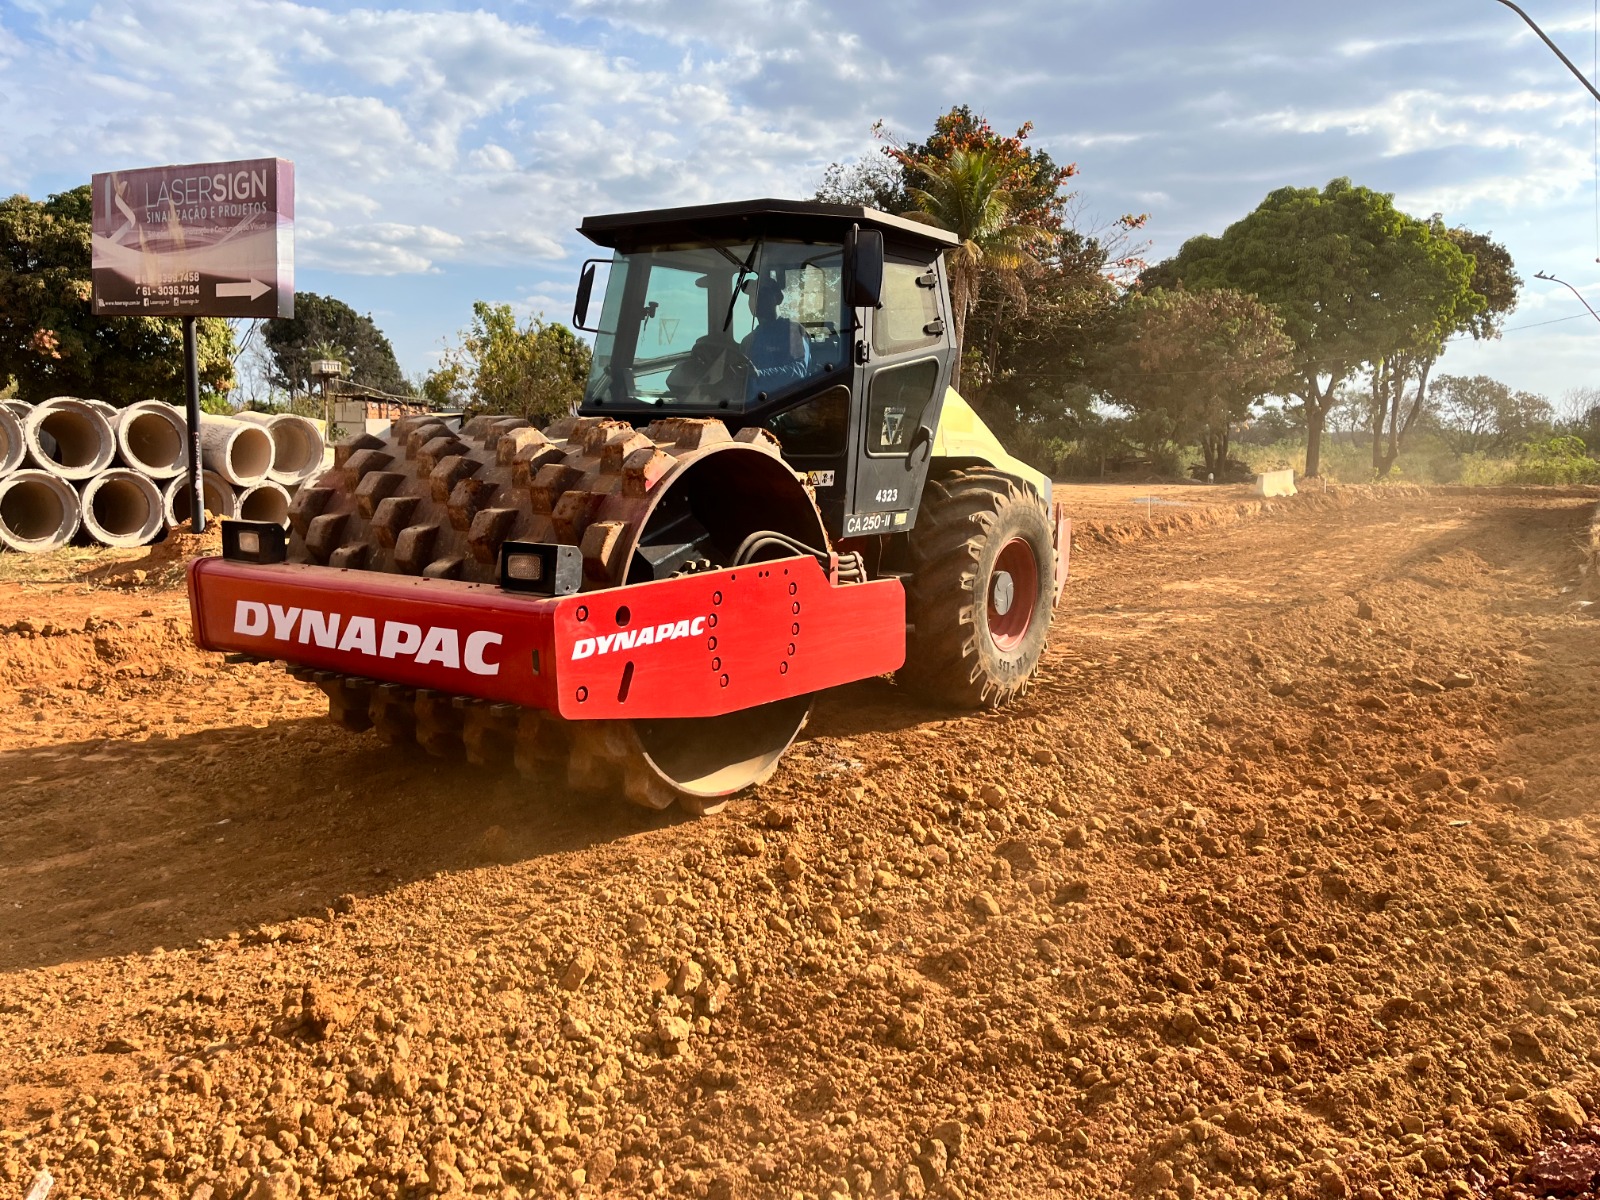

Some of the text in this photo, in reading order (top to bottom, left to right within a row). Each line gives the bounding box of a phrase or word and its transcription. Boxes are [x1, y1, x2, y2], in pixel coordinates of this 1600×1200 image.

[146, 169, 267, 208] LASERSIGN
[210, 207, 215, 218] E
[218, 201, 267, 218] PROJETOS
[142, 286, 152, 296] 61
[157, 284, 200, 296] 3036.7194
[875, 488, 898, 503] 4323
[847, 517, 861, 533] CA
[233, 599, 503, 676] DYNAPAC
[571, 615, 707, 661] DYNAPAC
